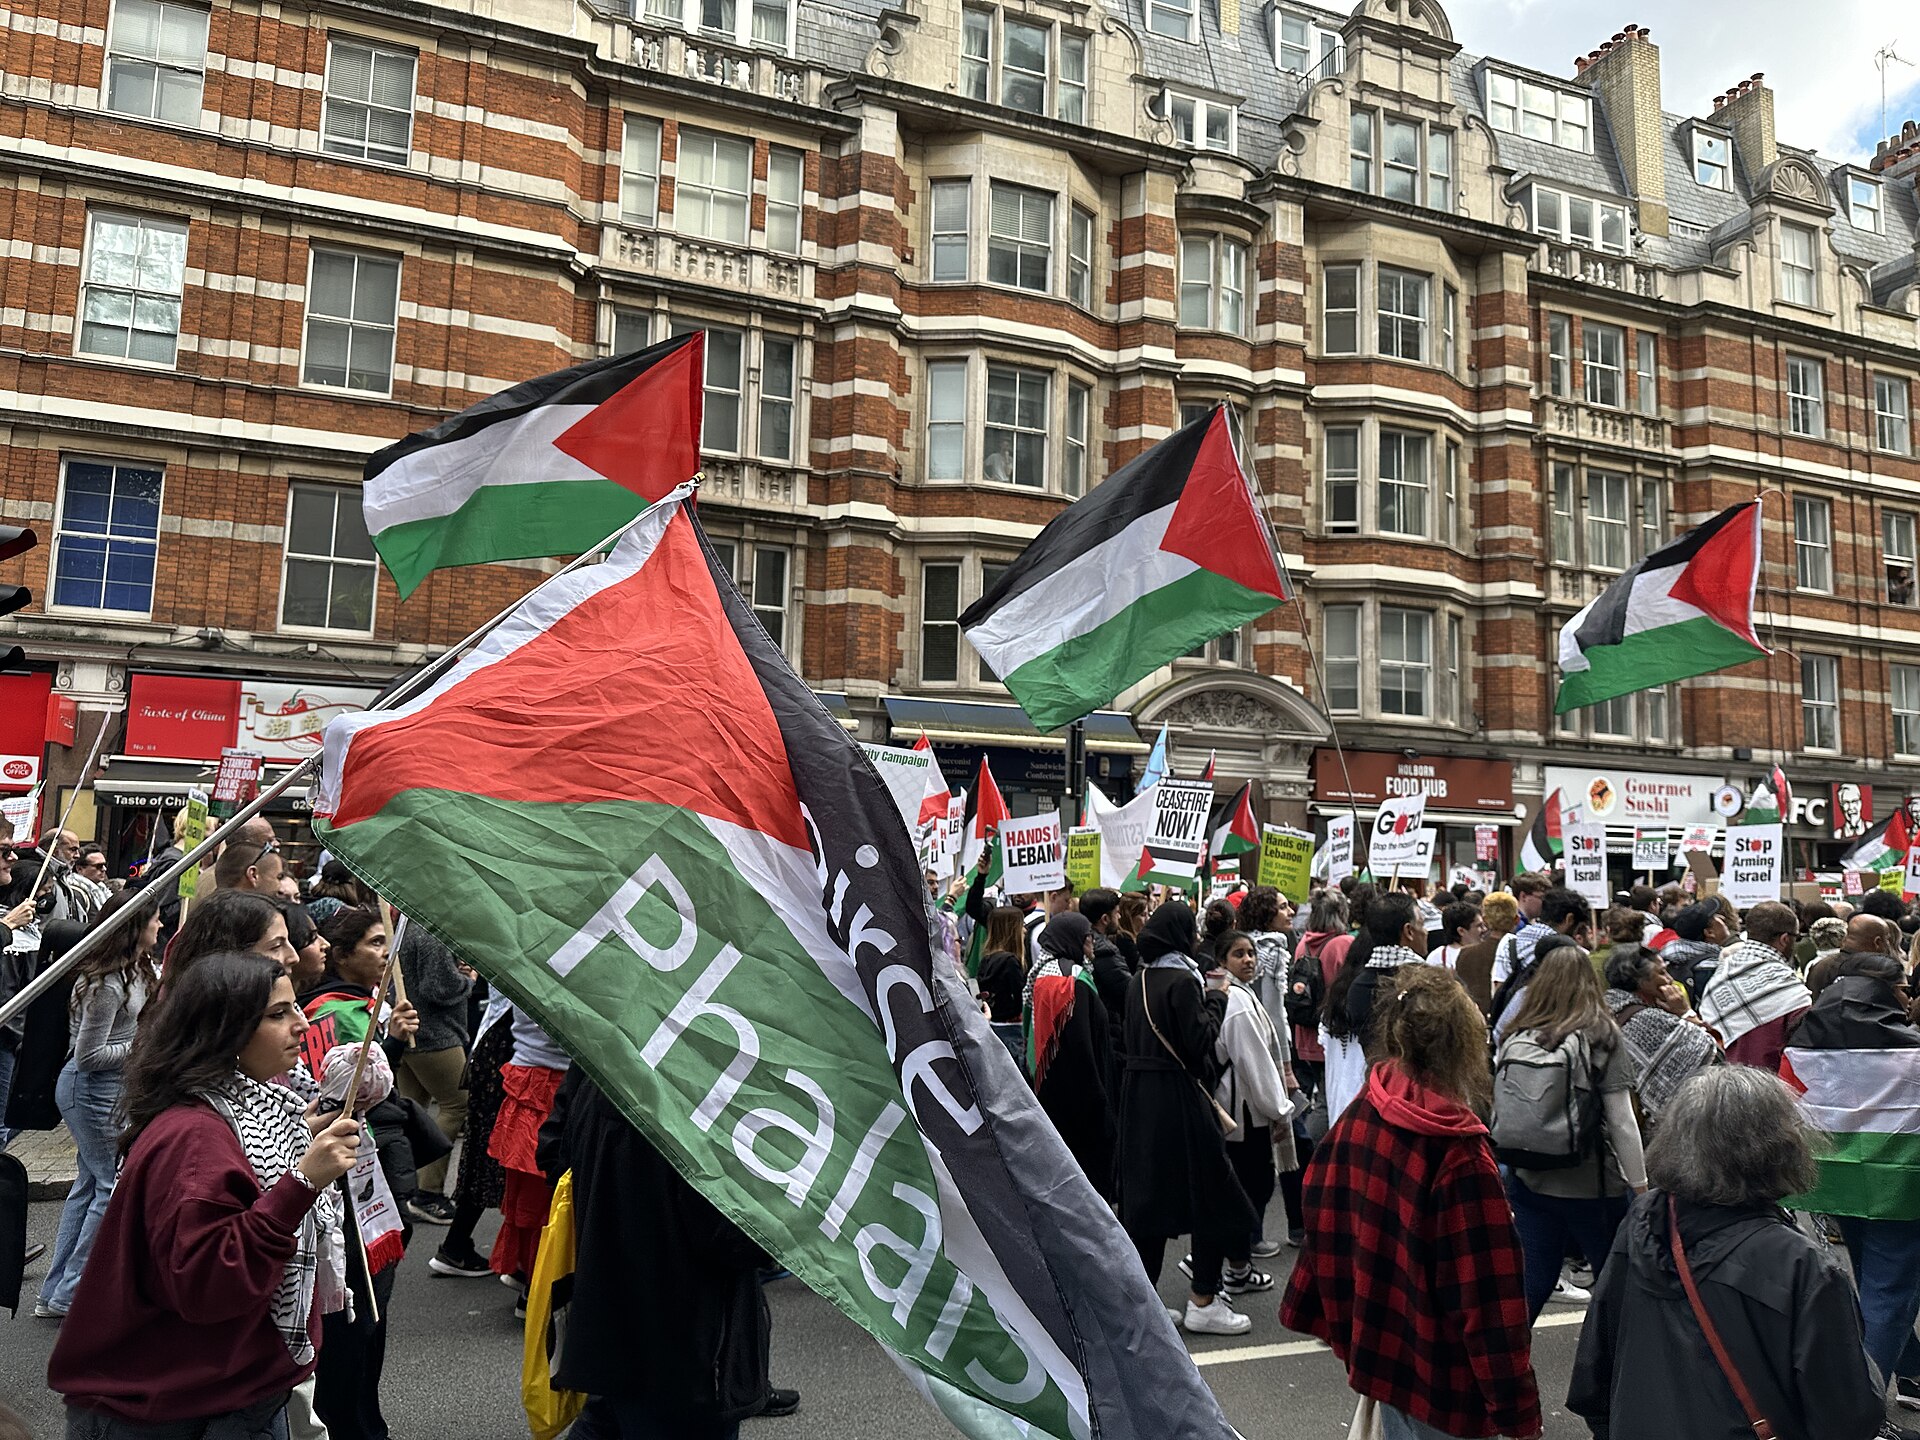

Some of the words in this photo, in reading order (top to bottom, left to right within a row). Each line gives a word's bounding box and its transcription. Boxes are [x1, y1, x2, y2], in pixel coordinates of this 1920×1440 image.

[140, 706, 172, 718] Taste
[174, 708, 189, 722] of
[192, 709, 226, 722] China
[882, 751, 929, 768] Campaign
[938, 756, 971, 766] bacconist
[1030, 762, 1065, 771] Sandwiche
[220, 768, 234, 779] HAS
[234, 769, 257, 781] BLOOD
[942, 767, 968, 775] gazines
[1025, 771, 1065, 779] Confectione
[1398, 763, 1435, 778] HOLBORN
[217, 778, 230, 788] ON
[1385, 777, 1419, 796] FOOD
[1421, 779, 1448, 798] HUB
[1625, 777, 1692, 797] Gourmet
[114, 795, 149, 805] Taste
[150, 795, 163, 806] of
[167, 795, 187, 806] Chi
[1156, 789, 1211, 813] CEASEFIRE
[1625, 795, 1669, 813] Sushi
[1782, 797, 1827, 826] FC
[1006, 825, 1051, 847] HANDS
[1266, 833, 1293, 849] Hands
[1296, 841, 1310, 853] off
[1373, 842, 1387, 851] Stop
[1572, 835, 1600, 853] Stop
[1636, 841, 1666, 855] FREE
[1735, 837, 1772, 853] Stop
[1007, 842, 1062, 867] LEBAN
[1070, 849, 1094, 860] Lebanon
[1264, 845, 1303, 864] Lebanon
[1571, 853, 1602, 868] Arming
[1732, 854, 1774, 869] Arming
[1734, 869, 1771, 882] Israel
